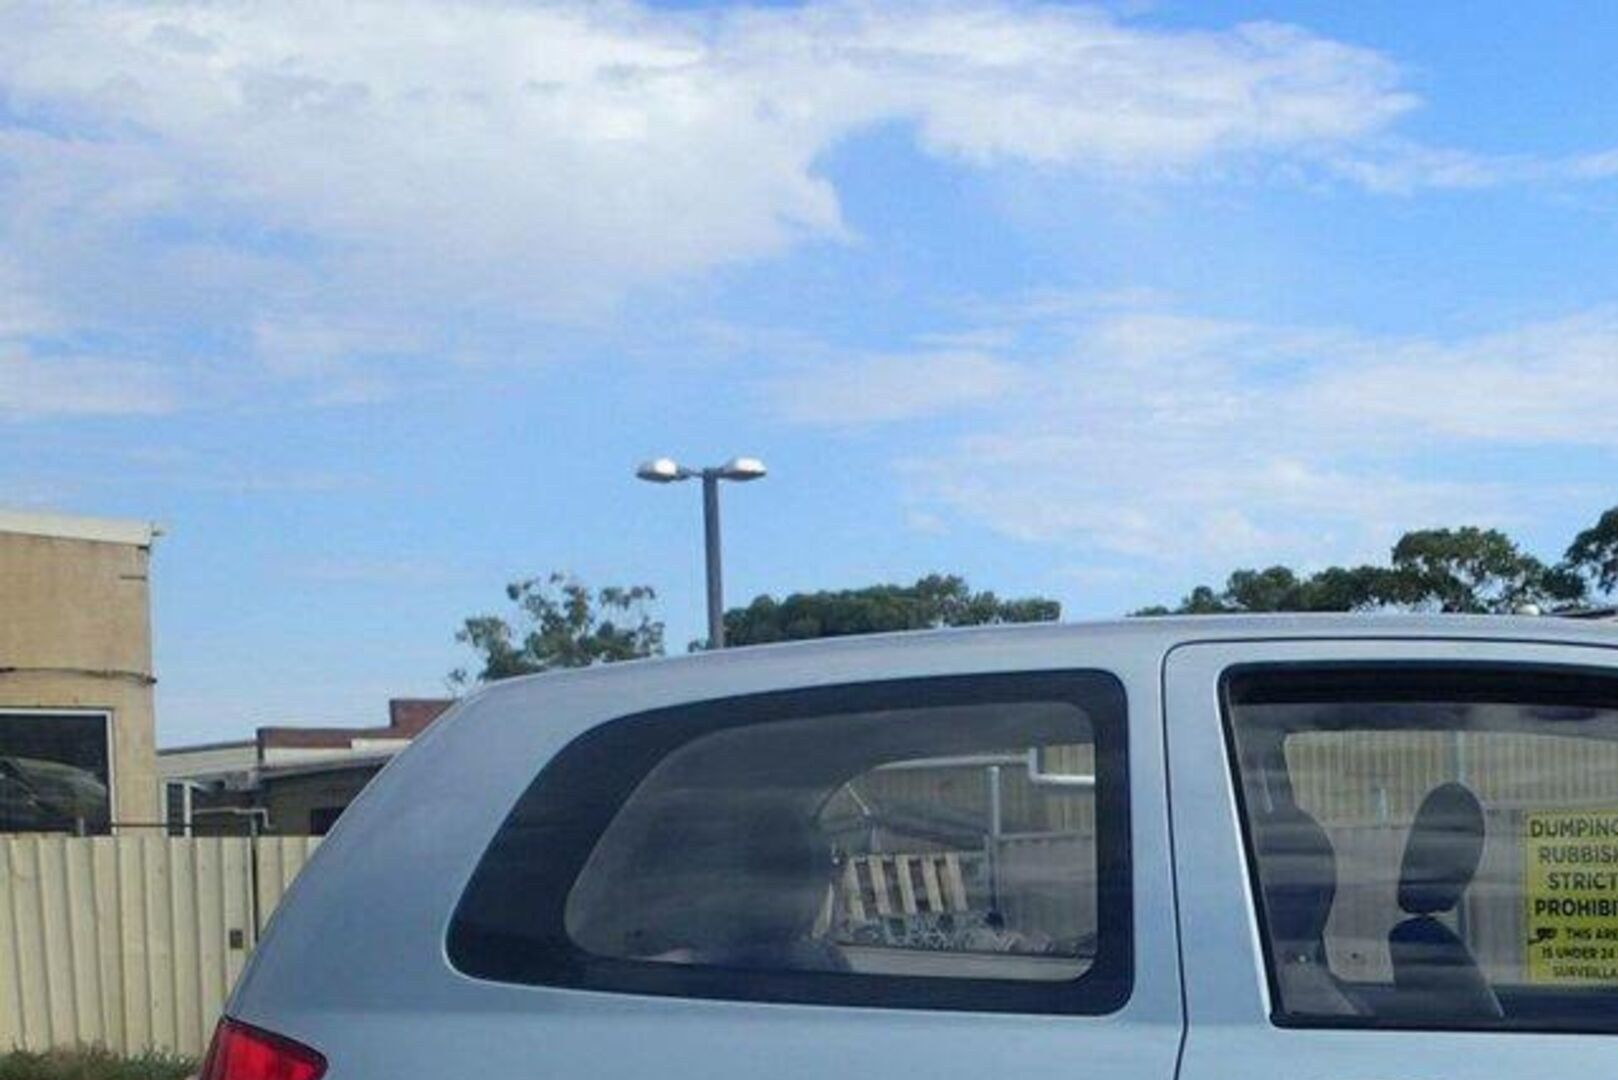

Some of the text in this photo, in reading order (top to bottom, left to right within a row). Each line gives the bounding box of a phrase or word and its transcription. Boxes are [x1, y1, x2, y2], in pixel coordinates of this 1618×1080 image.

[1566, 928, 1591, 940] THIS
[1542, 948, 1553, 959] IS
[1556, 948, 1598, 959] UNDER
[1601, 948, 1615, 959] 24
